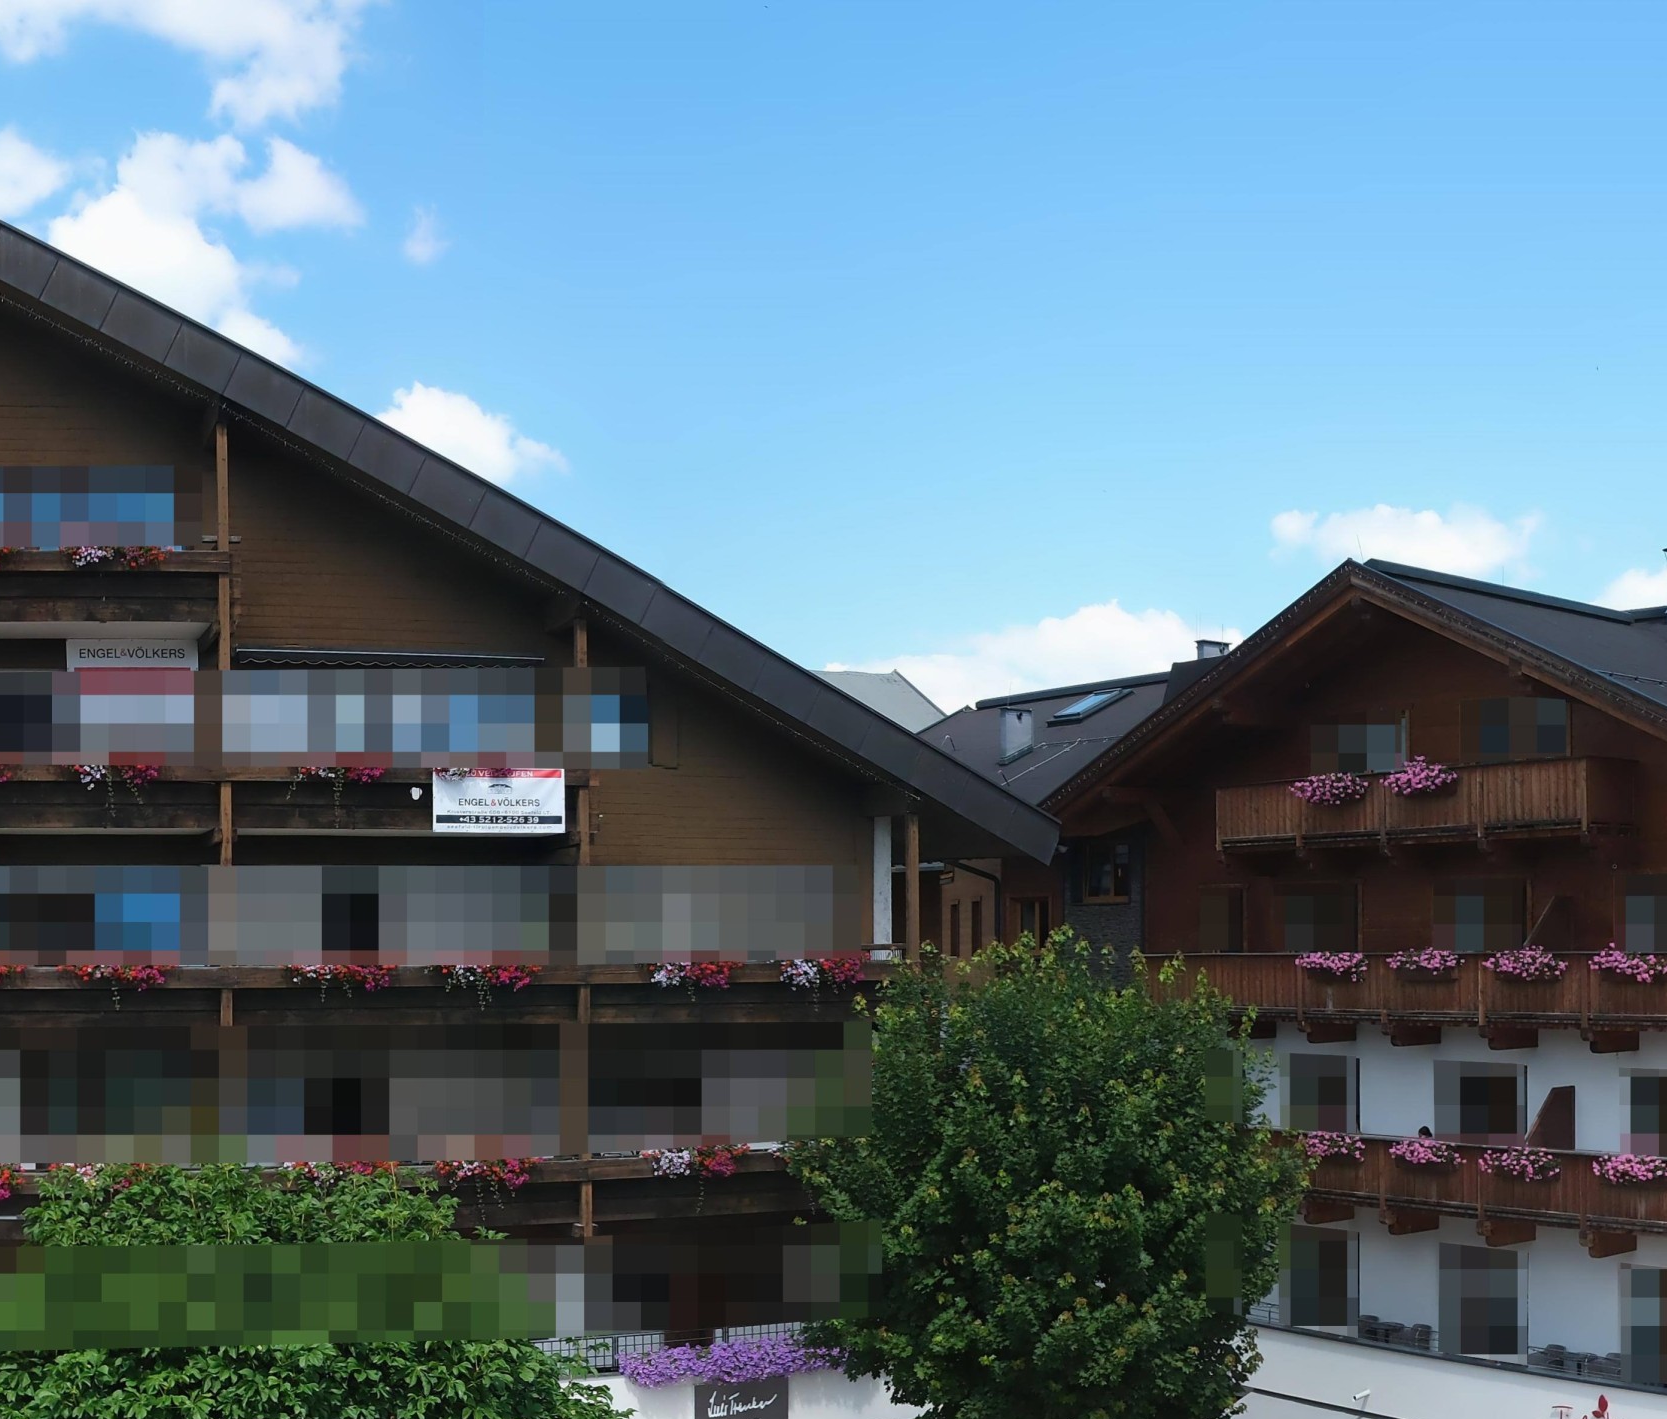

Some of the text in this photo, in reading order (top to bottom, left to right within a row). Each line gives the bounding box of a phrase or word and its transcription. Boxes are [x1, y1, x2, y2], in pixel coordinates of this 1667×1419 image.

[79, 646, 186, 659] ENGEL&VÖLKERS
[478, 769, 534, 777] VEUFEN
[458, 797, 541, 807] ENGEL&VÖLKERS
